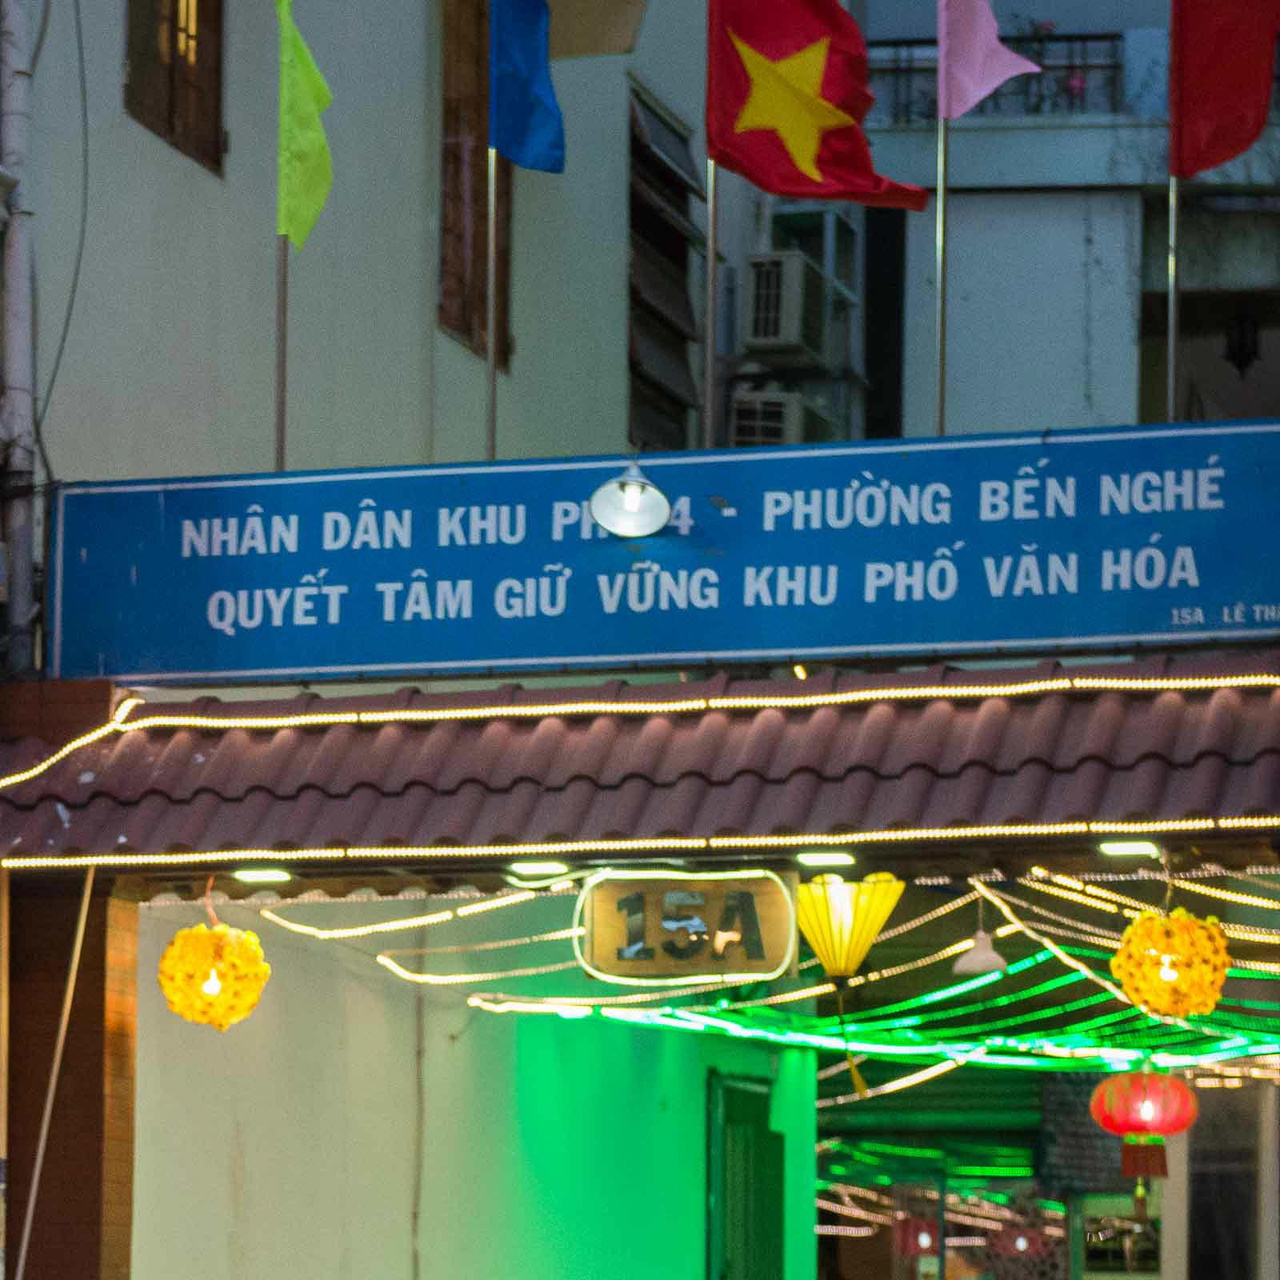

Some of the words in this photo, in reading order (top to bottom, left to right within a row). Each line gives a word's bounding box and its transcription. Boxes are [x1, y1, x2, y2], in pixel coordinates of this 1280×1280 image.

[182, 504, 299, 557] NHÂN
[323, 498, 413, 552] DÂN
[438, 505, 526, 547] KHU
[762, 471, 951, 532] PHƯỜNG
[979, 457, 1076, 522] BẾN
[1100, 454, 1225, 516] NGHÉ
[207, 568, 347, 635] QUYẾT
[376, 568, 472, 620] TÂM
[494, 563, 572, 618] GIỮ
[597, 561, 718, 614] VỮNG
[743, 565, 838, 606] KHU
[864, 541, 965, 602] PHỐ
[983, 543, 1078, 598] VĂN
[1101, 533, 1199, 590] HÓA
[1171, 606, 1204, 625] 15A
[617, 890, 767, 961] 15A
